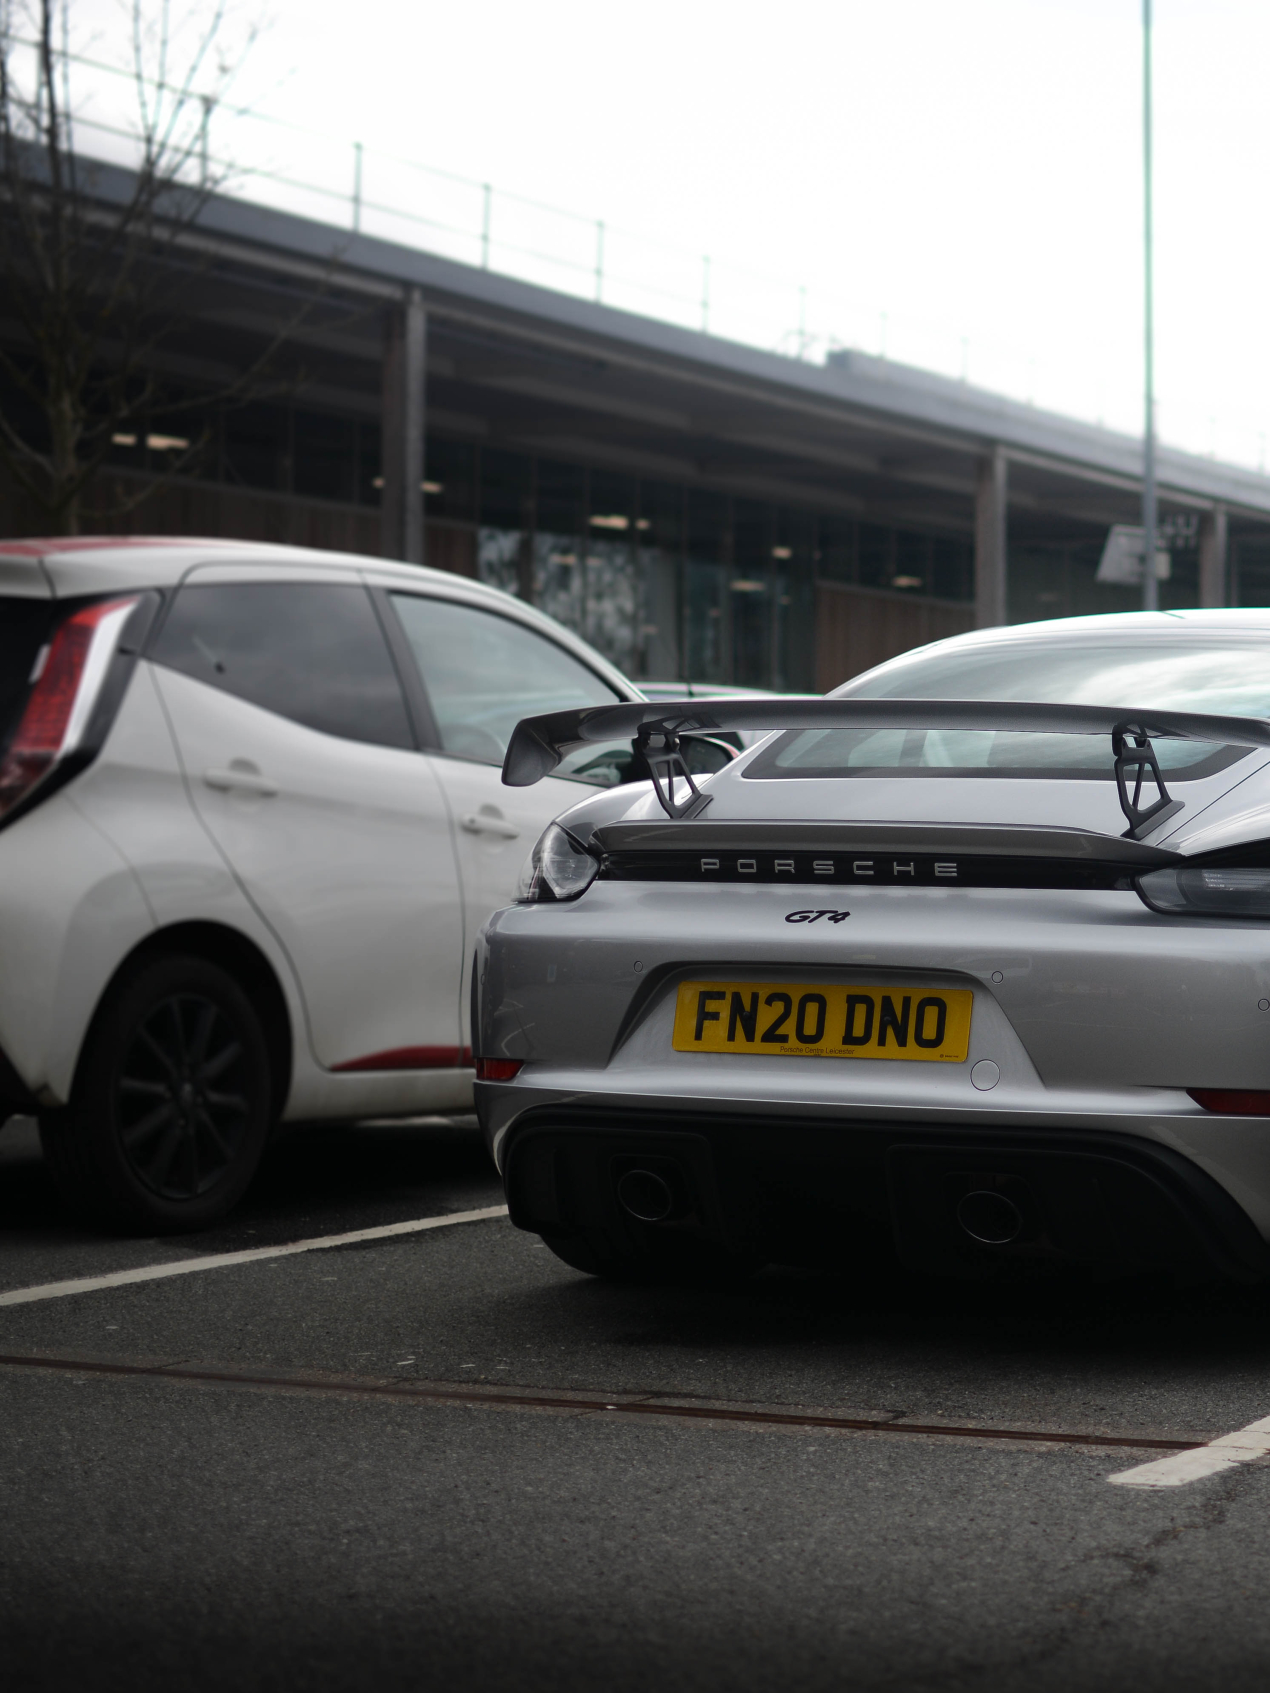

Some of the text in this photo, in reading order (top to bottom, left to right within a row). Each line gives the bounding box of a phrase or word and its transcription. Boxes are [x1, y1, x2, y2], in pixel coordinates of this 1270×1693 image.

[700, 858, 958, 876] PORSCHE
[784, 910, 851, 924] GT4
[694, 990, 948, 1049] FN20 DNO
[826, 1047, 855, 1055] Leicester
